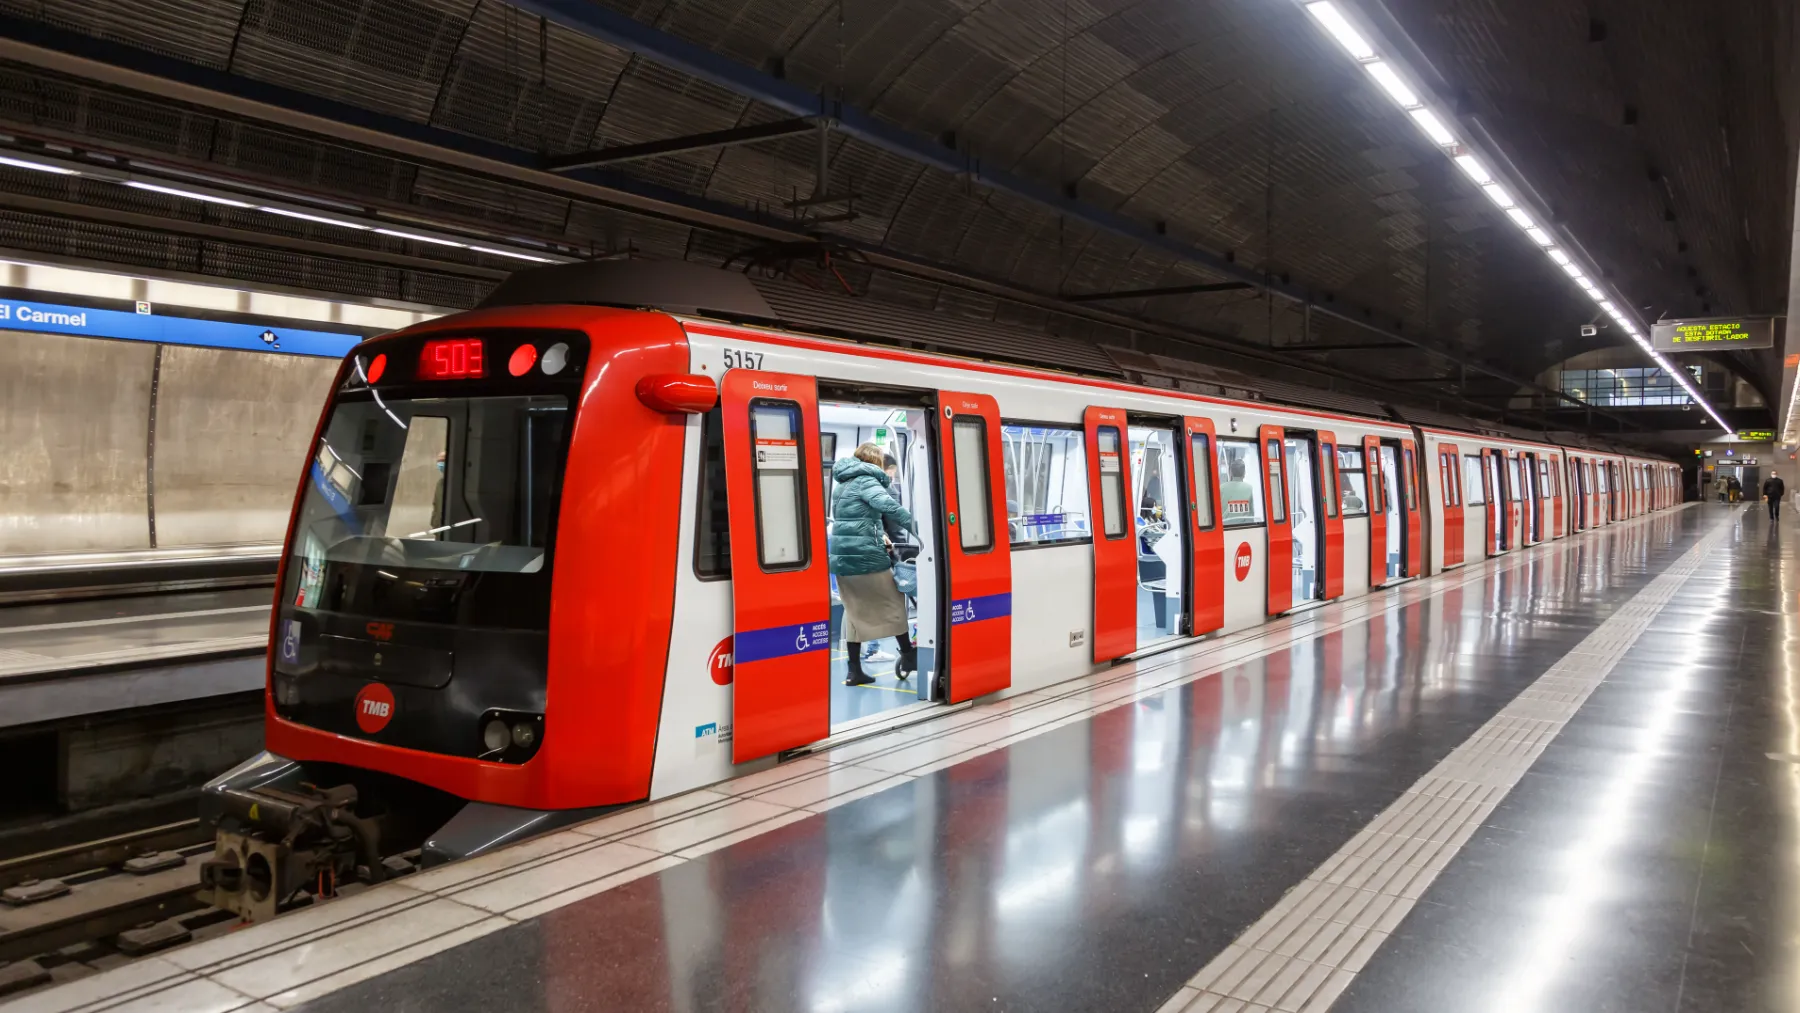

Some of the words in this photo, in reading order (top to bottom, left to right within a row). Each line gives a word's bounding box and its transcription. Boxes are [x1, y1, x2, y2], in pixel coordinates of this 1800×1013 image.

[16, 306, 87, 327] Carmel
[435, 342, 482, 376] 503
[723, 347, 764, 371] 5157
[1237, 555, 1250, 568] TMB
[717, 653, 734, 669] TM
[363, 699, 390, 717] TMB
[701, 726, 715, 737] ATM
